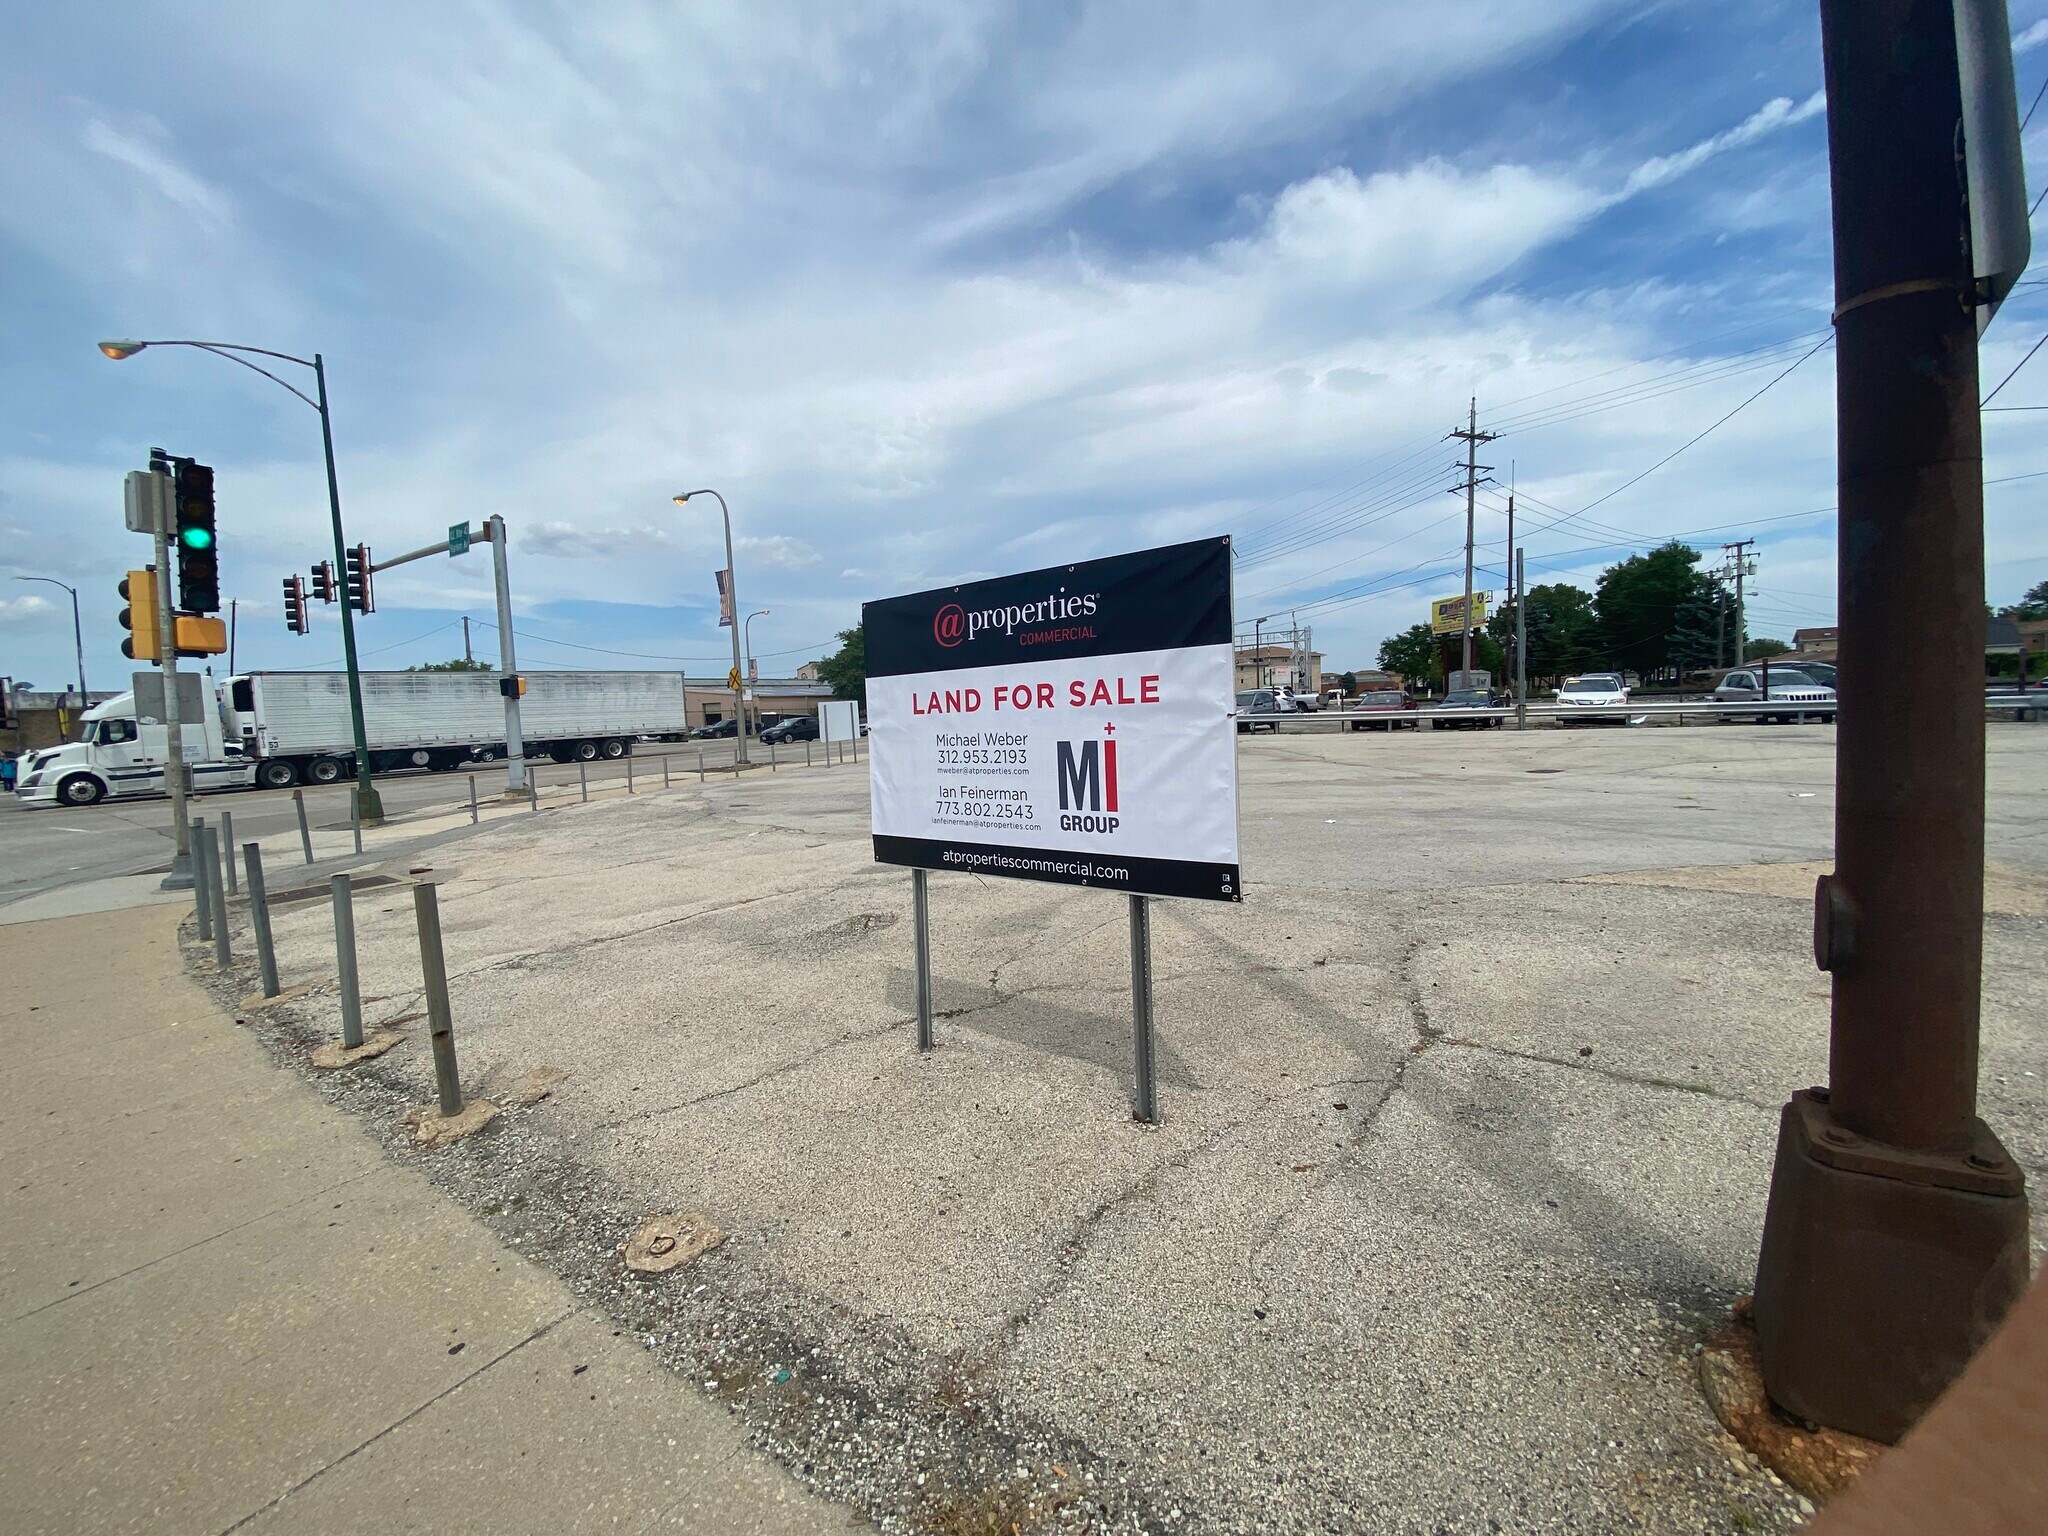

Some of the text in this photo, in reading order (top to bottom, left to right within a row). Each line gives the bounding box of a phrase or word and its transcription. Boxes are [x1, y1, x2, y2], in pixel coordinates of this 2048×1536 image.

[1019, 626, 1098, 647] COMMERCIAL
[912, 674, 1160, 715] LAND FOR SALE
[936, 731, 1029, 747] Michael Weber
[938, 749, 1028, 764] 312.953.2193
[937, 766, 1030, 775] mweber@atproperties.com
[939, 785, 1028, 801] Ian Feinerman
[936, 800, 1034, 820] 773.802.2543
[931, 816, 1042, 832] ianfeinerman@atproperties.com
[1059, 814, 1120, 834] GROUP
[943, 850, 1129, 880] atpropertiescommercial.com
